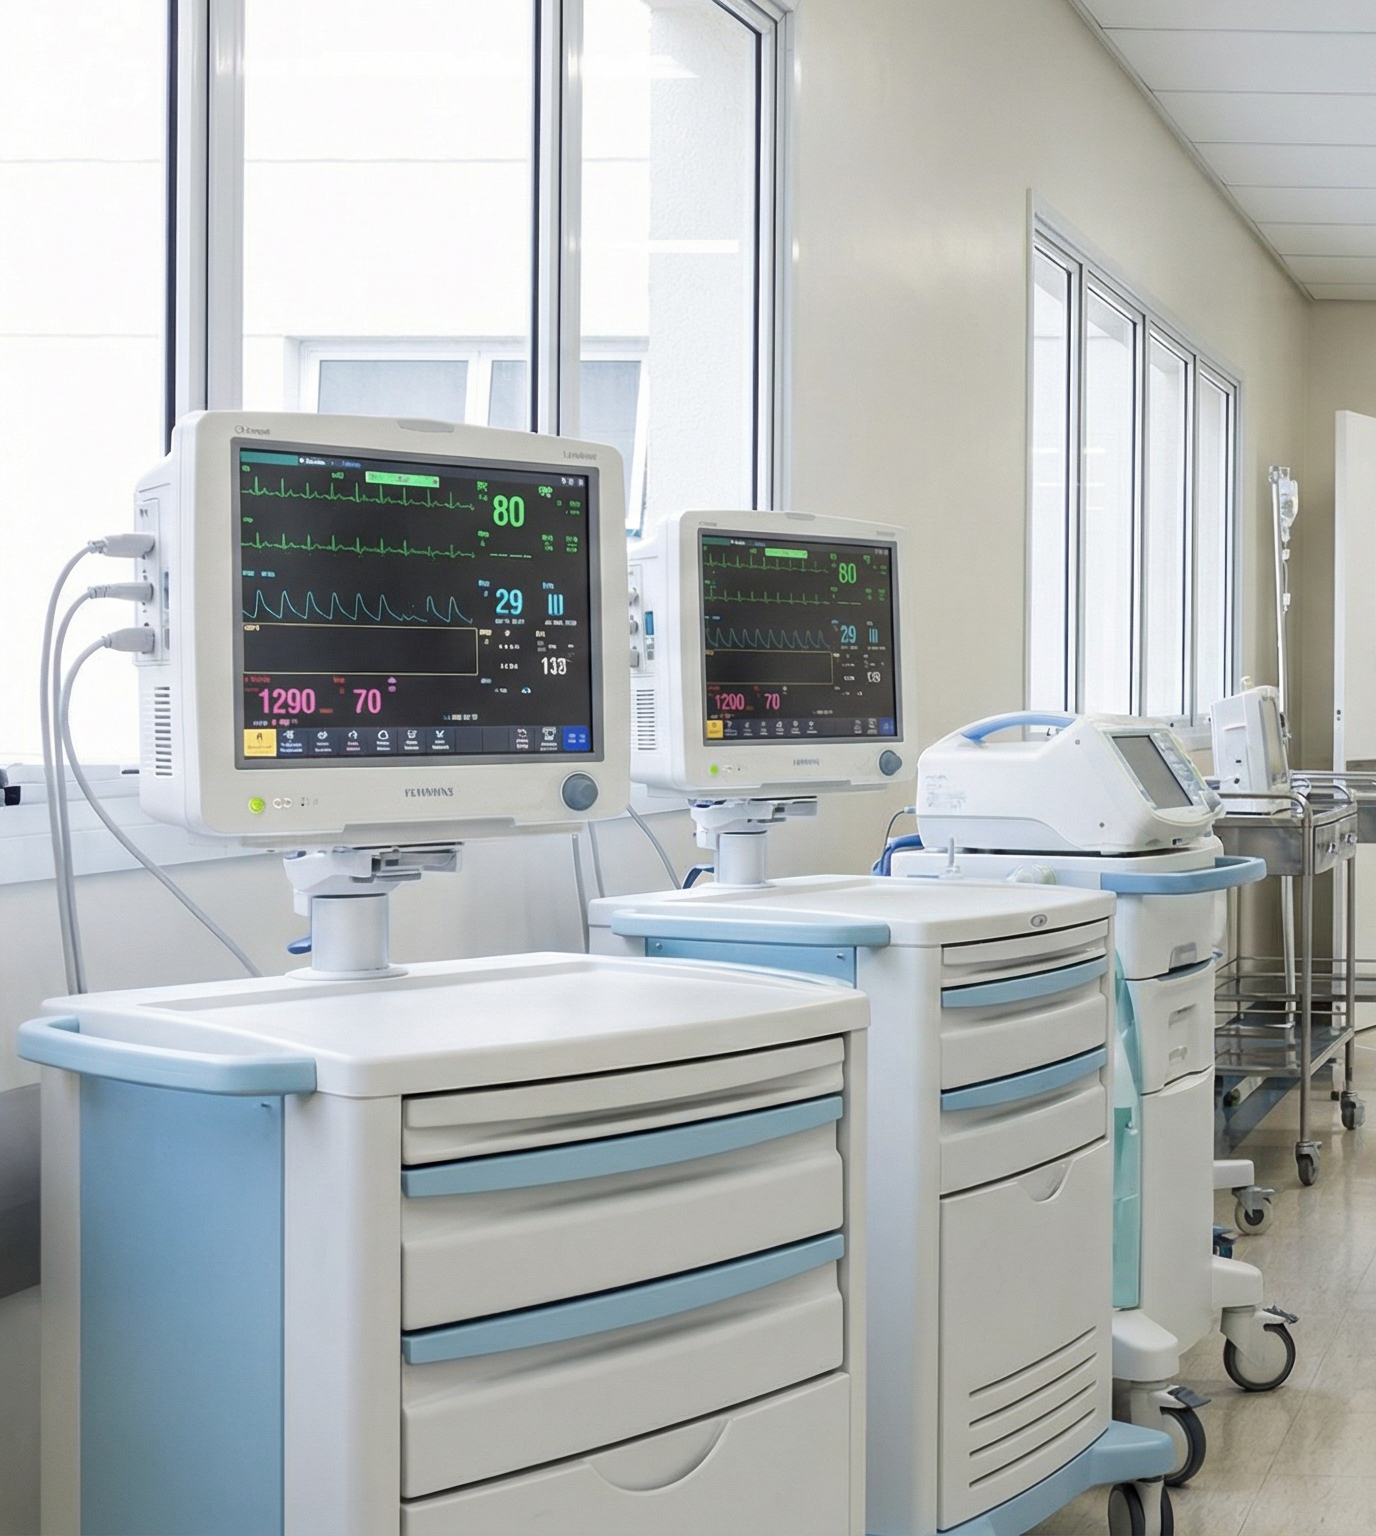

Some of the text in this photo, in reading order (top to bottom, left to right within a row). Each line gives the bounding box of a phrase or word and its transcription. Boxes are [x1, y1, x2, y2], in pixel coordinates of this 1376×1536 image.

[493, 495, 525, 528] 80
[838, 562, 857, 584] 80
[495, 588, 523, 615] 29
[840, 625, 857, 643] 29
[258, 688, 316, 714] 1290
[353, 688, 382, 714] 70
[764, 693, 780, 711] 70
